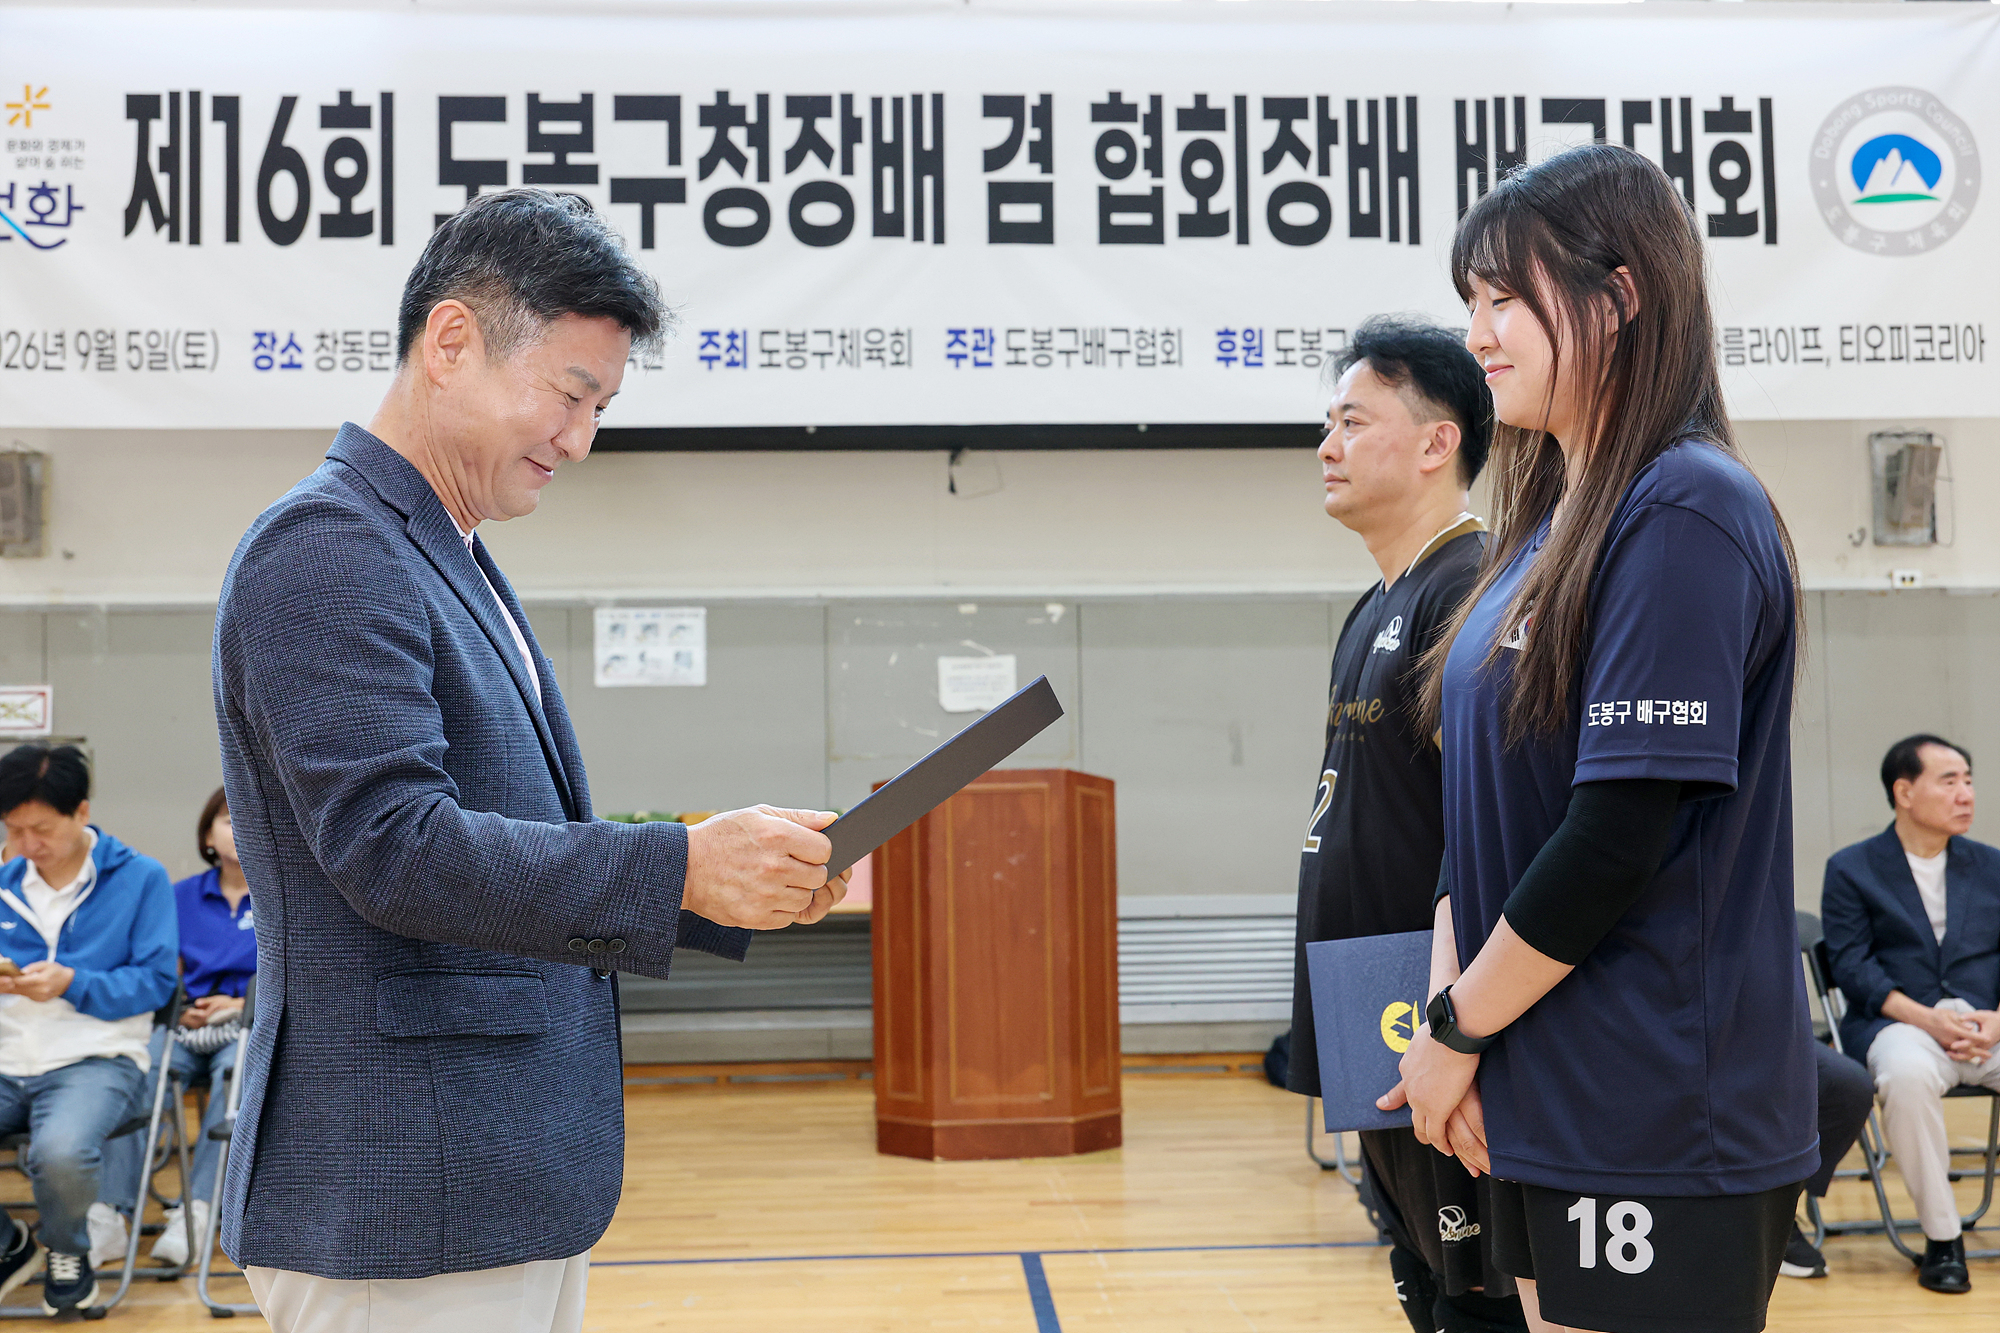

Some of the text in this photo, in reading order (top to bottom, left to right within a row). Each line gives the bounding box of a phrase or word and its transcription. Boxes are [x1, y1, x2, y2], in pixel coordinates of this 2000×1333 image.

[124, 91, 394, 246] 제16회
[434, 91, 945, 250] 도봉구청장배
[982, 93, 1054, 245] 겸
[1090, 91, 1421, 246] 협회장배
[0, 328, 219, 372] 26년 9월 5일(토)
[252, 330, 303, 372] 장소
[698, 329, 748, 371] 주최
[758, 328, 912, 369] 도봉구체육회
[945, 327, 1183, 369] 주관 도봉구배구협회
[1215, 327, 1265, 369] 후원
[1717, 323, 1986, 367] 름라이프, 티오피코리아
[1587, 699, 1708, 727] 도봉구 배구협회
[1567, 1196, 1654, 1275] 18
